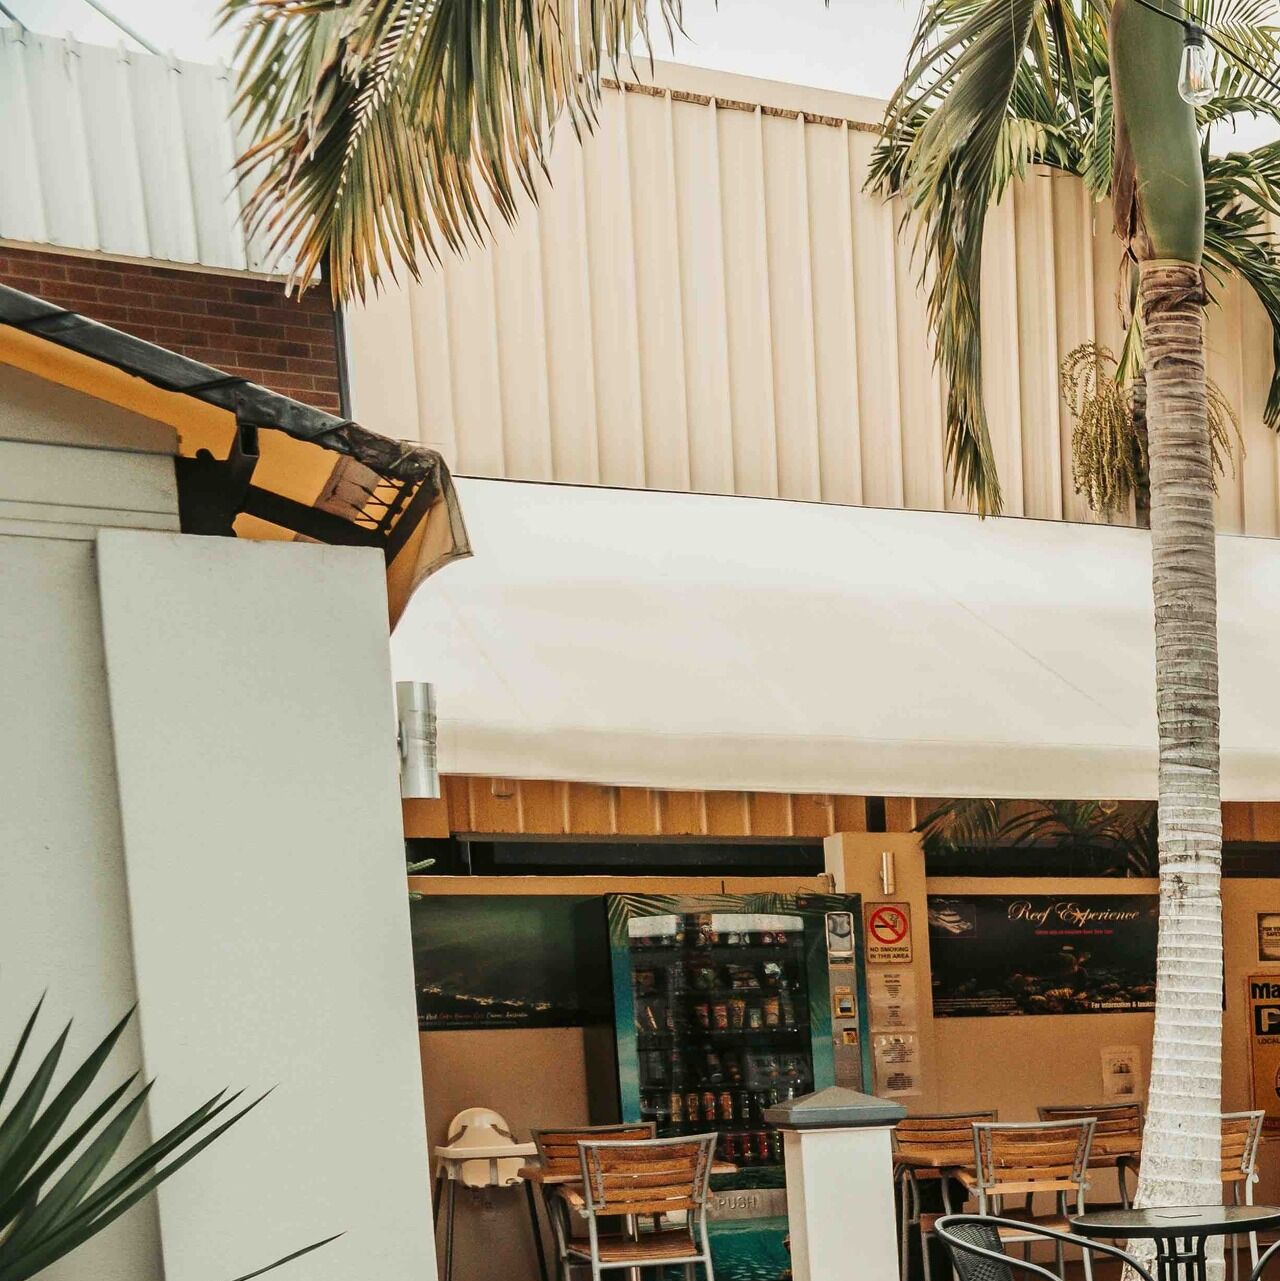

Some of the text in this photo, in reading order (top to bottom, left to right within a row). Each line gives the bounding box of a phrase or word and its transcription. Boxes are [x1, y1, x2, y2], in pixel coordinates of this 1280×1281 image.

[1007, 900, 1140, 928] Reef Experience
[718, 1195, 757, 1210] PUSH
